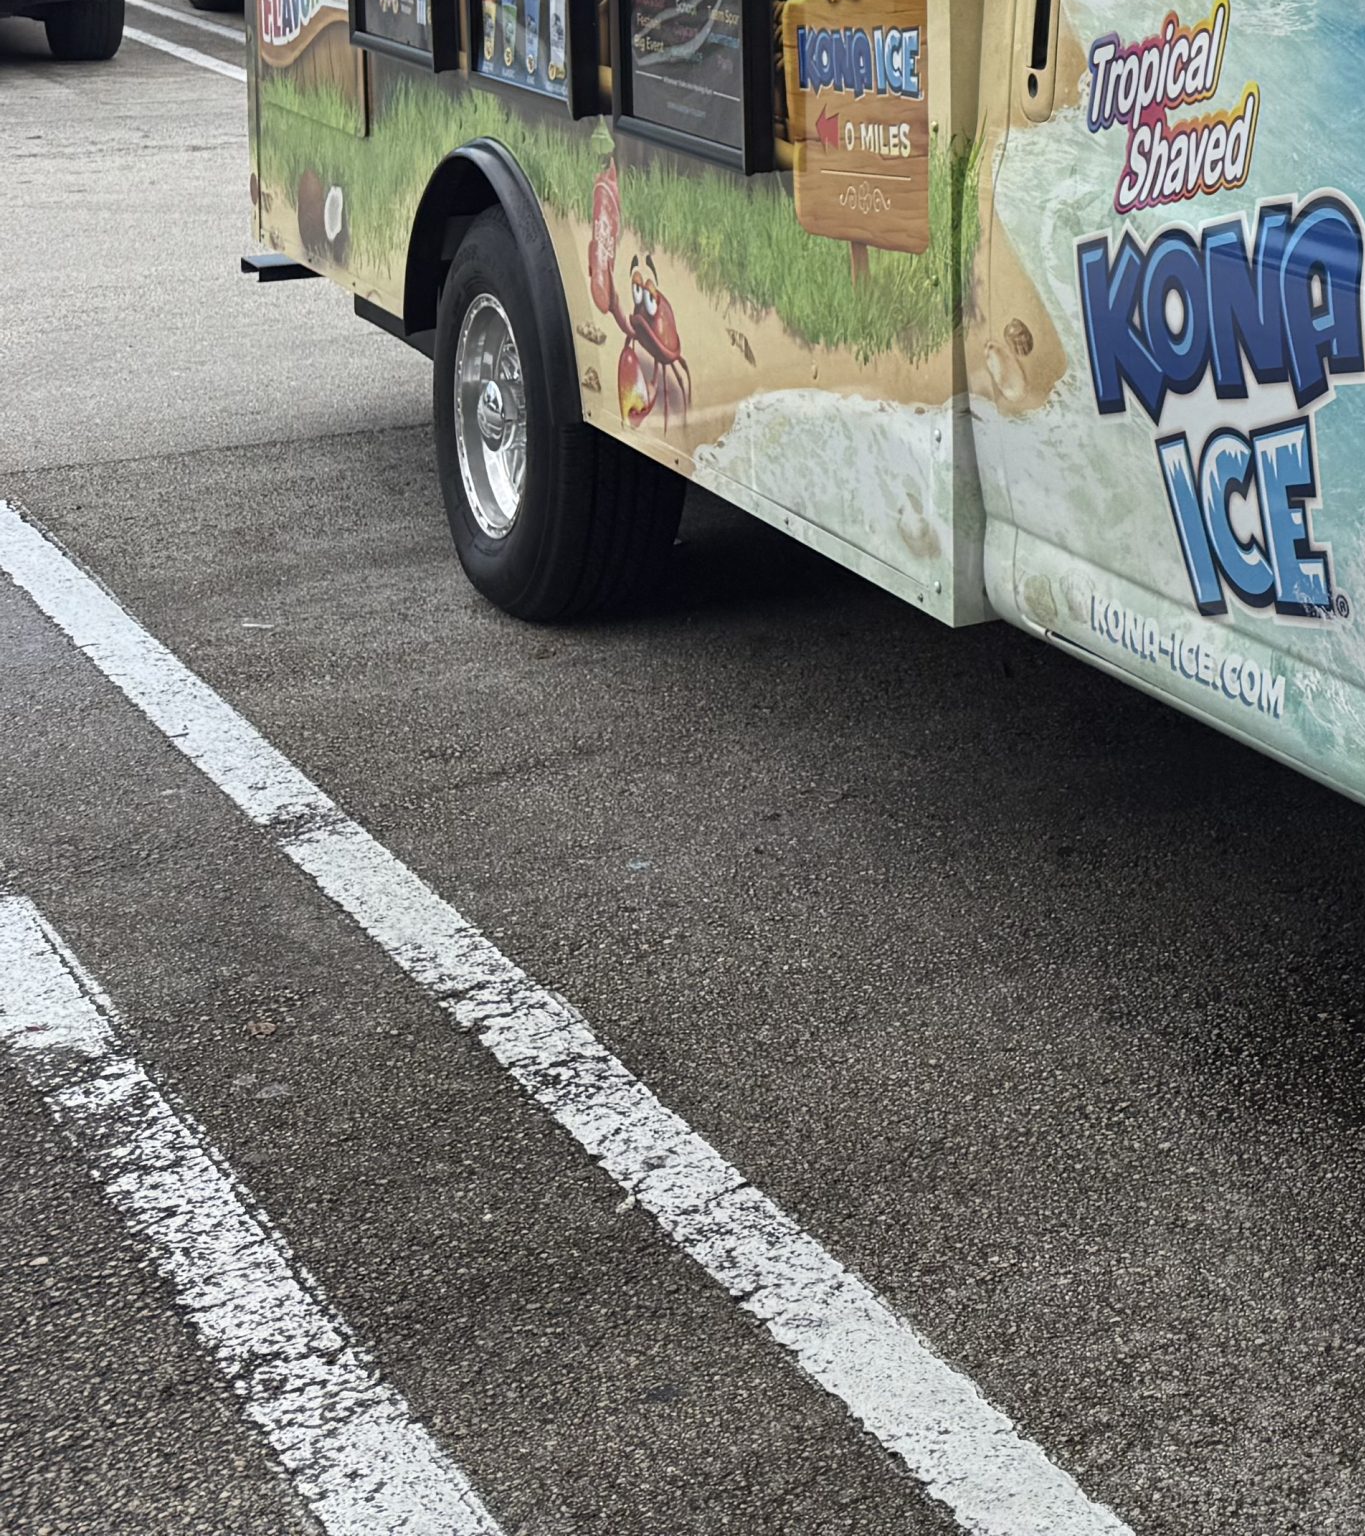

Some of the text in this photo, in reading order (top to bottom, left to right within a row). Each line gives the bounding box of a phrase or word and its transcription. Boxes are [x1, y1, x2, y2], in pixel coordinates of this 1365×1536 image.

[797, 24, 922, 100] KONA ICE
[1090, 0, 1228, 131] Tropical
[860, 122, 911, 158] MILES
[1117, 88, 1257, 210] Shaved
[1155, 415, 1333, 618] ICE
[1090, 595, 1286, 719] KONA-ICE.COM
